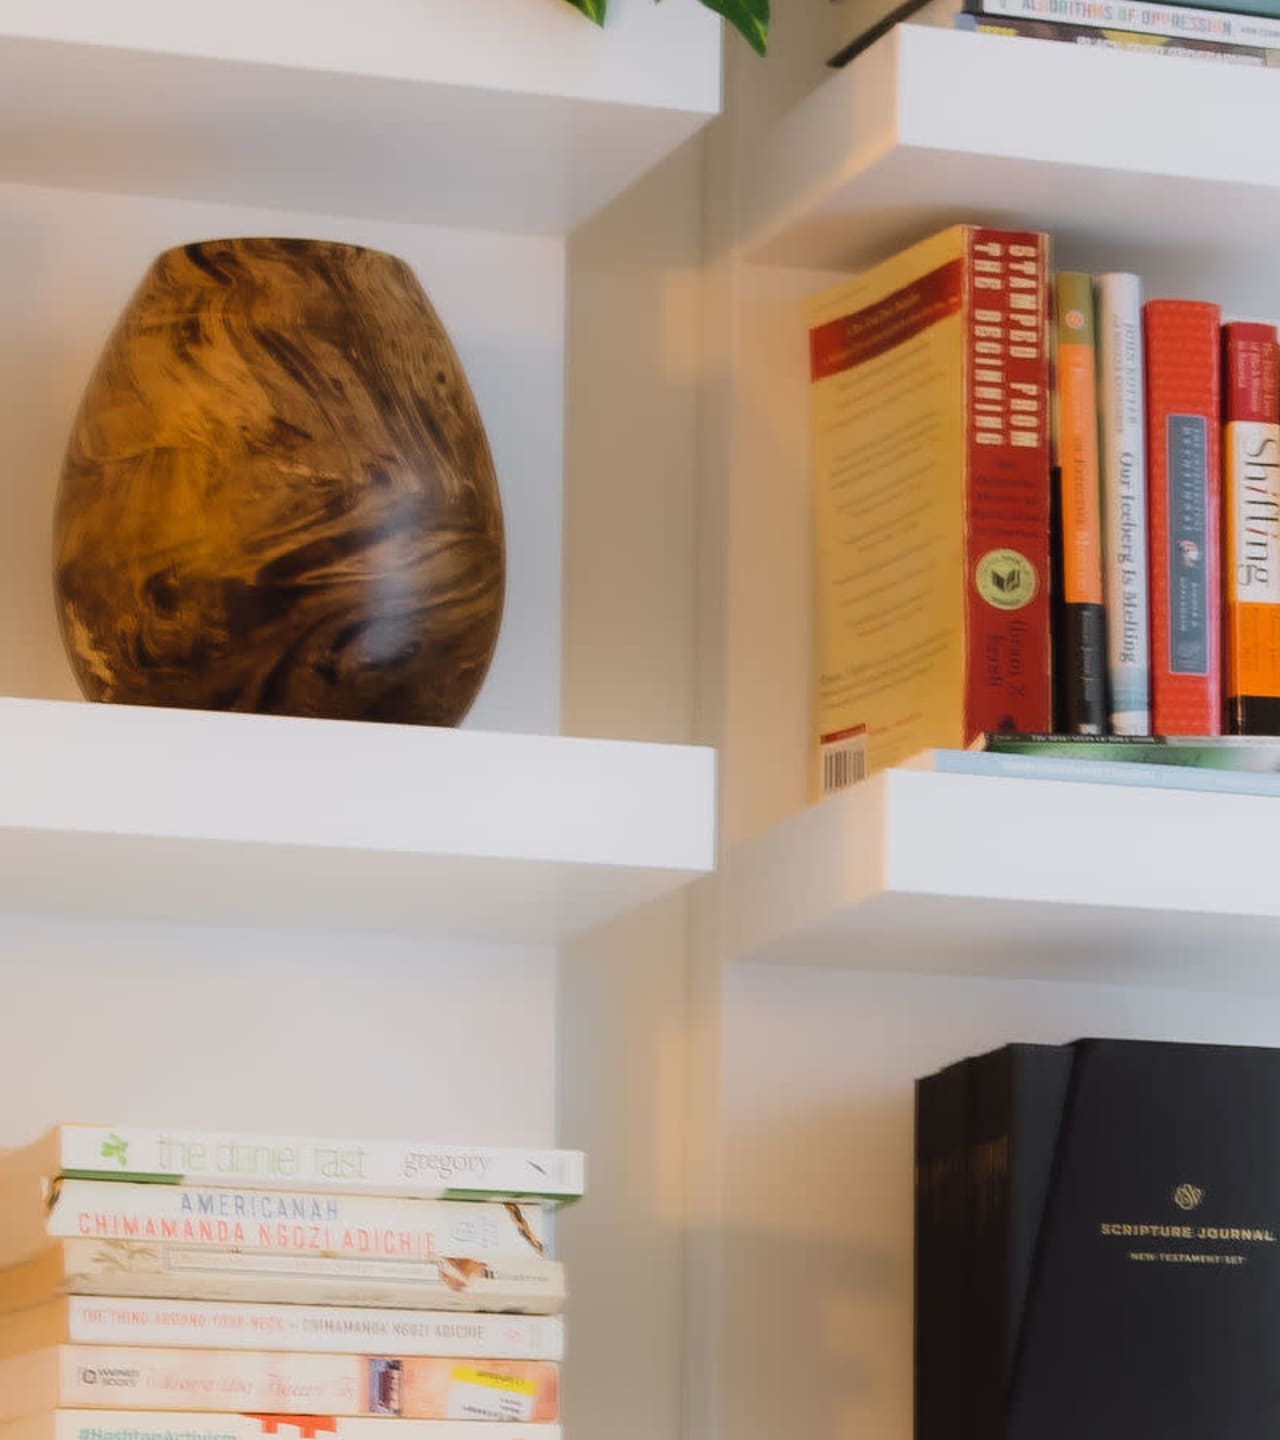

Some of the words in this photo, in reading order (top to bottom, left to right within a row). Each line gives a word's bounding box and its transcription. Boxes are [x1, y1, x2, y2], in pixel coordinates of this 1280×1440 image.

[973, 242, 1004, 291] THE
[1008, 243, 1040, 360] STAMPED
[973, 309, 1004, 448] BEGINNING
[1009, 382, 1041, 449] FROM
[1119, 450, 1138, 491] Our
[1116, 495, 1139, 563] Iceberg
[1121, 568, 1137, 586] Is
[1118, 590, 1139, 665] Melting
[402, 1151, 490, 1180] gregory
[180, 1192, 339, 1219] AMERICANAH
[78, 1212, 246, 1243] CHIMAMANDA
[257, 1222, 331, 1250] NGOZI
[341, 1228, 438, 1258] ADICHIE
[1101, 1223, 1193, 1239] SCRIPTURE
[1198, 1227, 1278, 1242] JOURNAL
